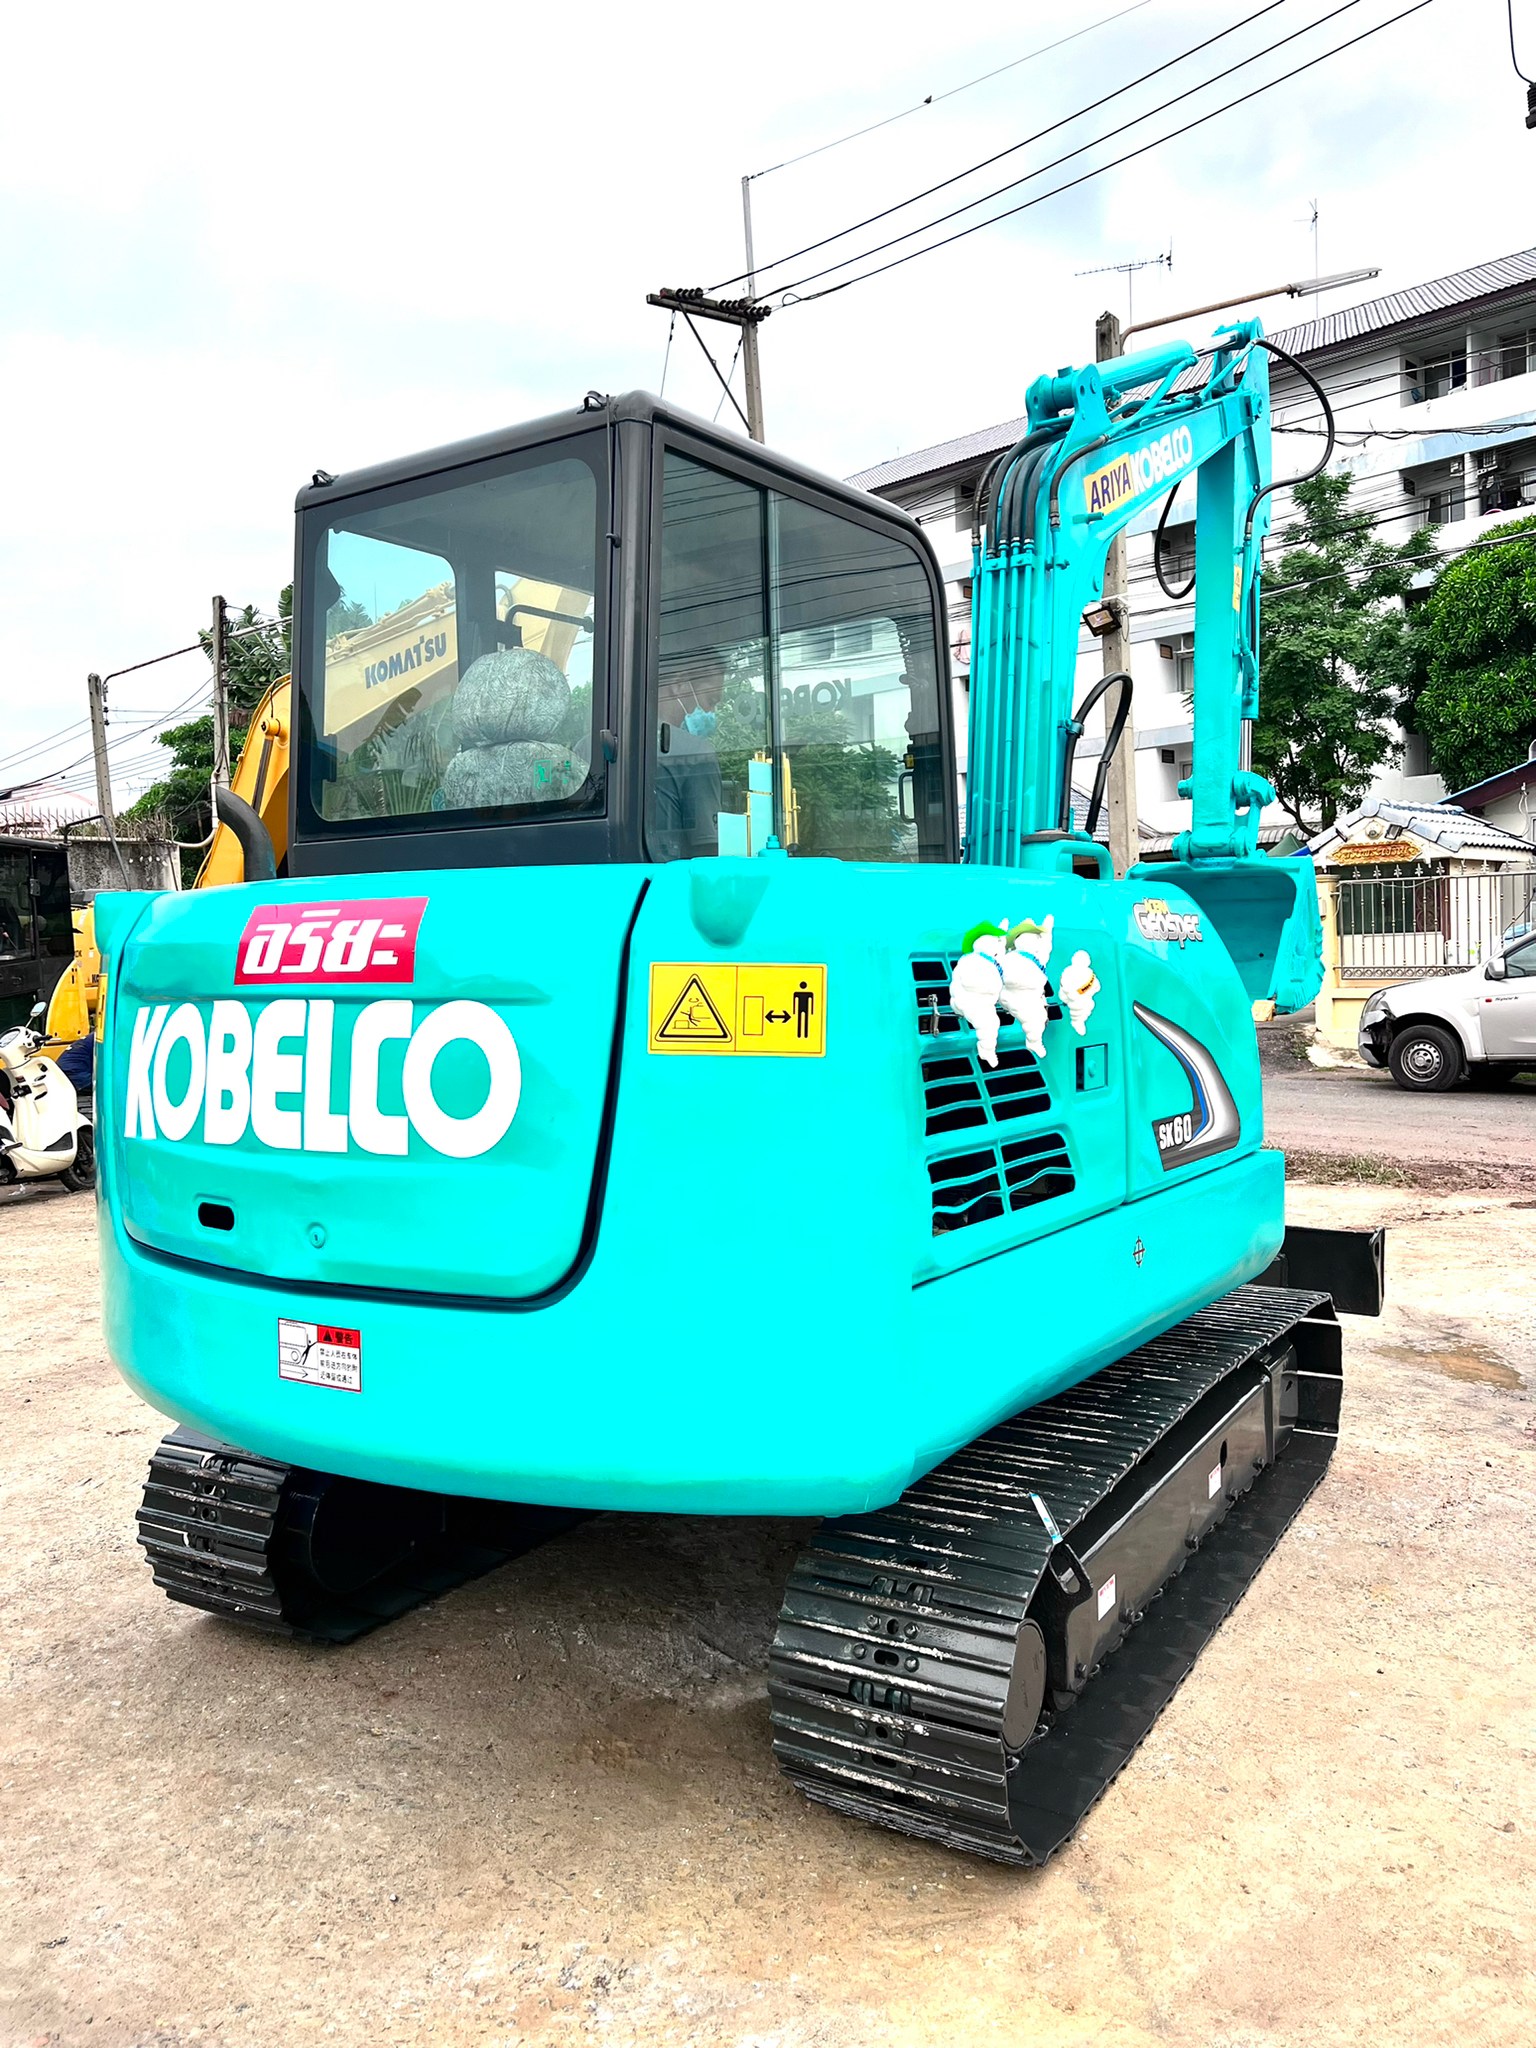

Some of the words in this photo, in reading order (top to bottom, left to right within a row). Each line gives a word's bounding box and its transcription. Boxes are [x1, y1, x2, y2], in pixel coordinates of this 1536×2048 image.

[1091, 462, 1131, 513] ARIYA
[1130, 424, 1193, 496] KOBELCO
[365, 632, 447, 689] KOMATSU
[242, 908, 407, 975] อริยะ
[124, 999, 522, 1159] KOBELCO
